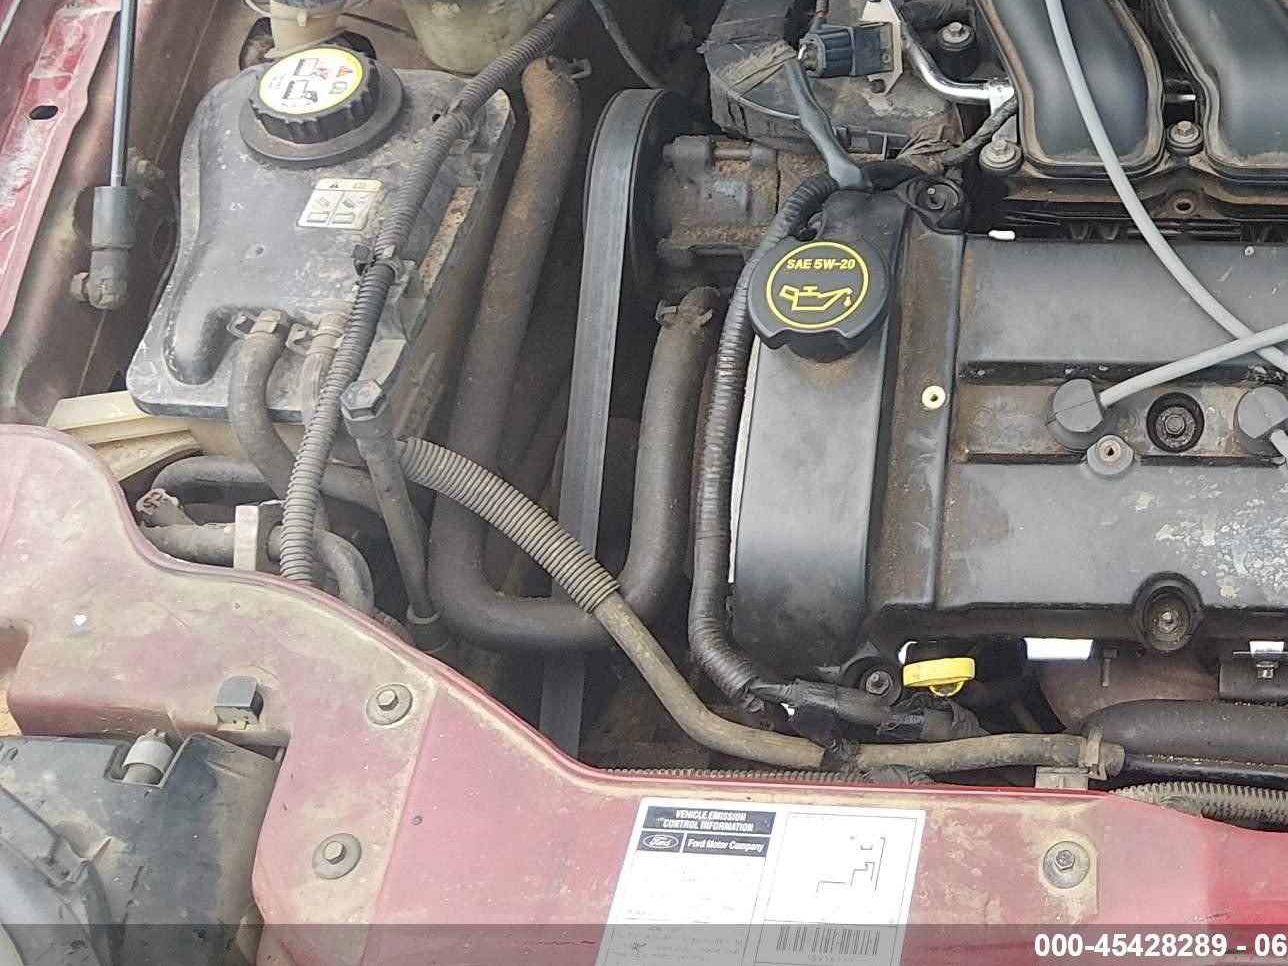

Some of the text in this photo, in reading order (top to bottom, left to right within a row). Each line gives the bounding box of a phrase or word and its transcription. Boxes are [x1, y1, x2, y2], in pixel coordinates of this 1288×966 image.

[786, 258, 856, 270] SAE 5W-20
[675, 810, 747, 822] VEHICLE EMISSION
[663, 819, 754, 832] CONTROL INFORMATION
[687, 839, 764, 853] Ford Motor Company
